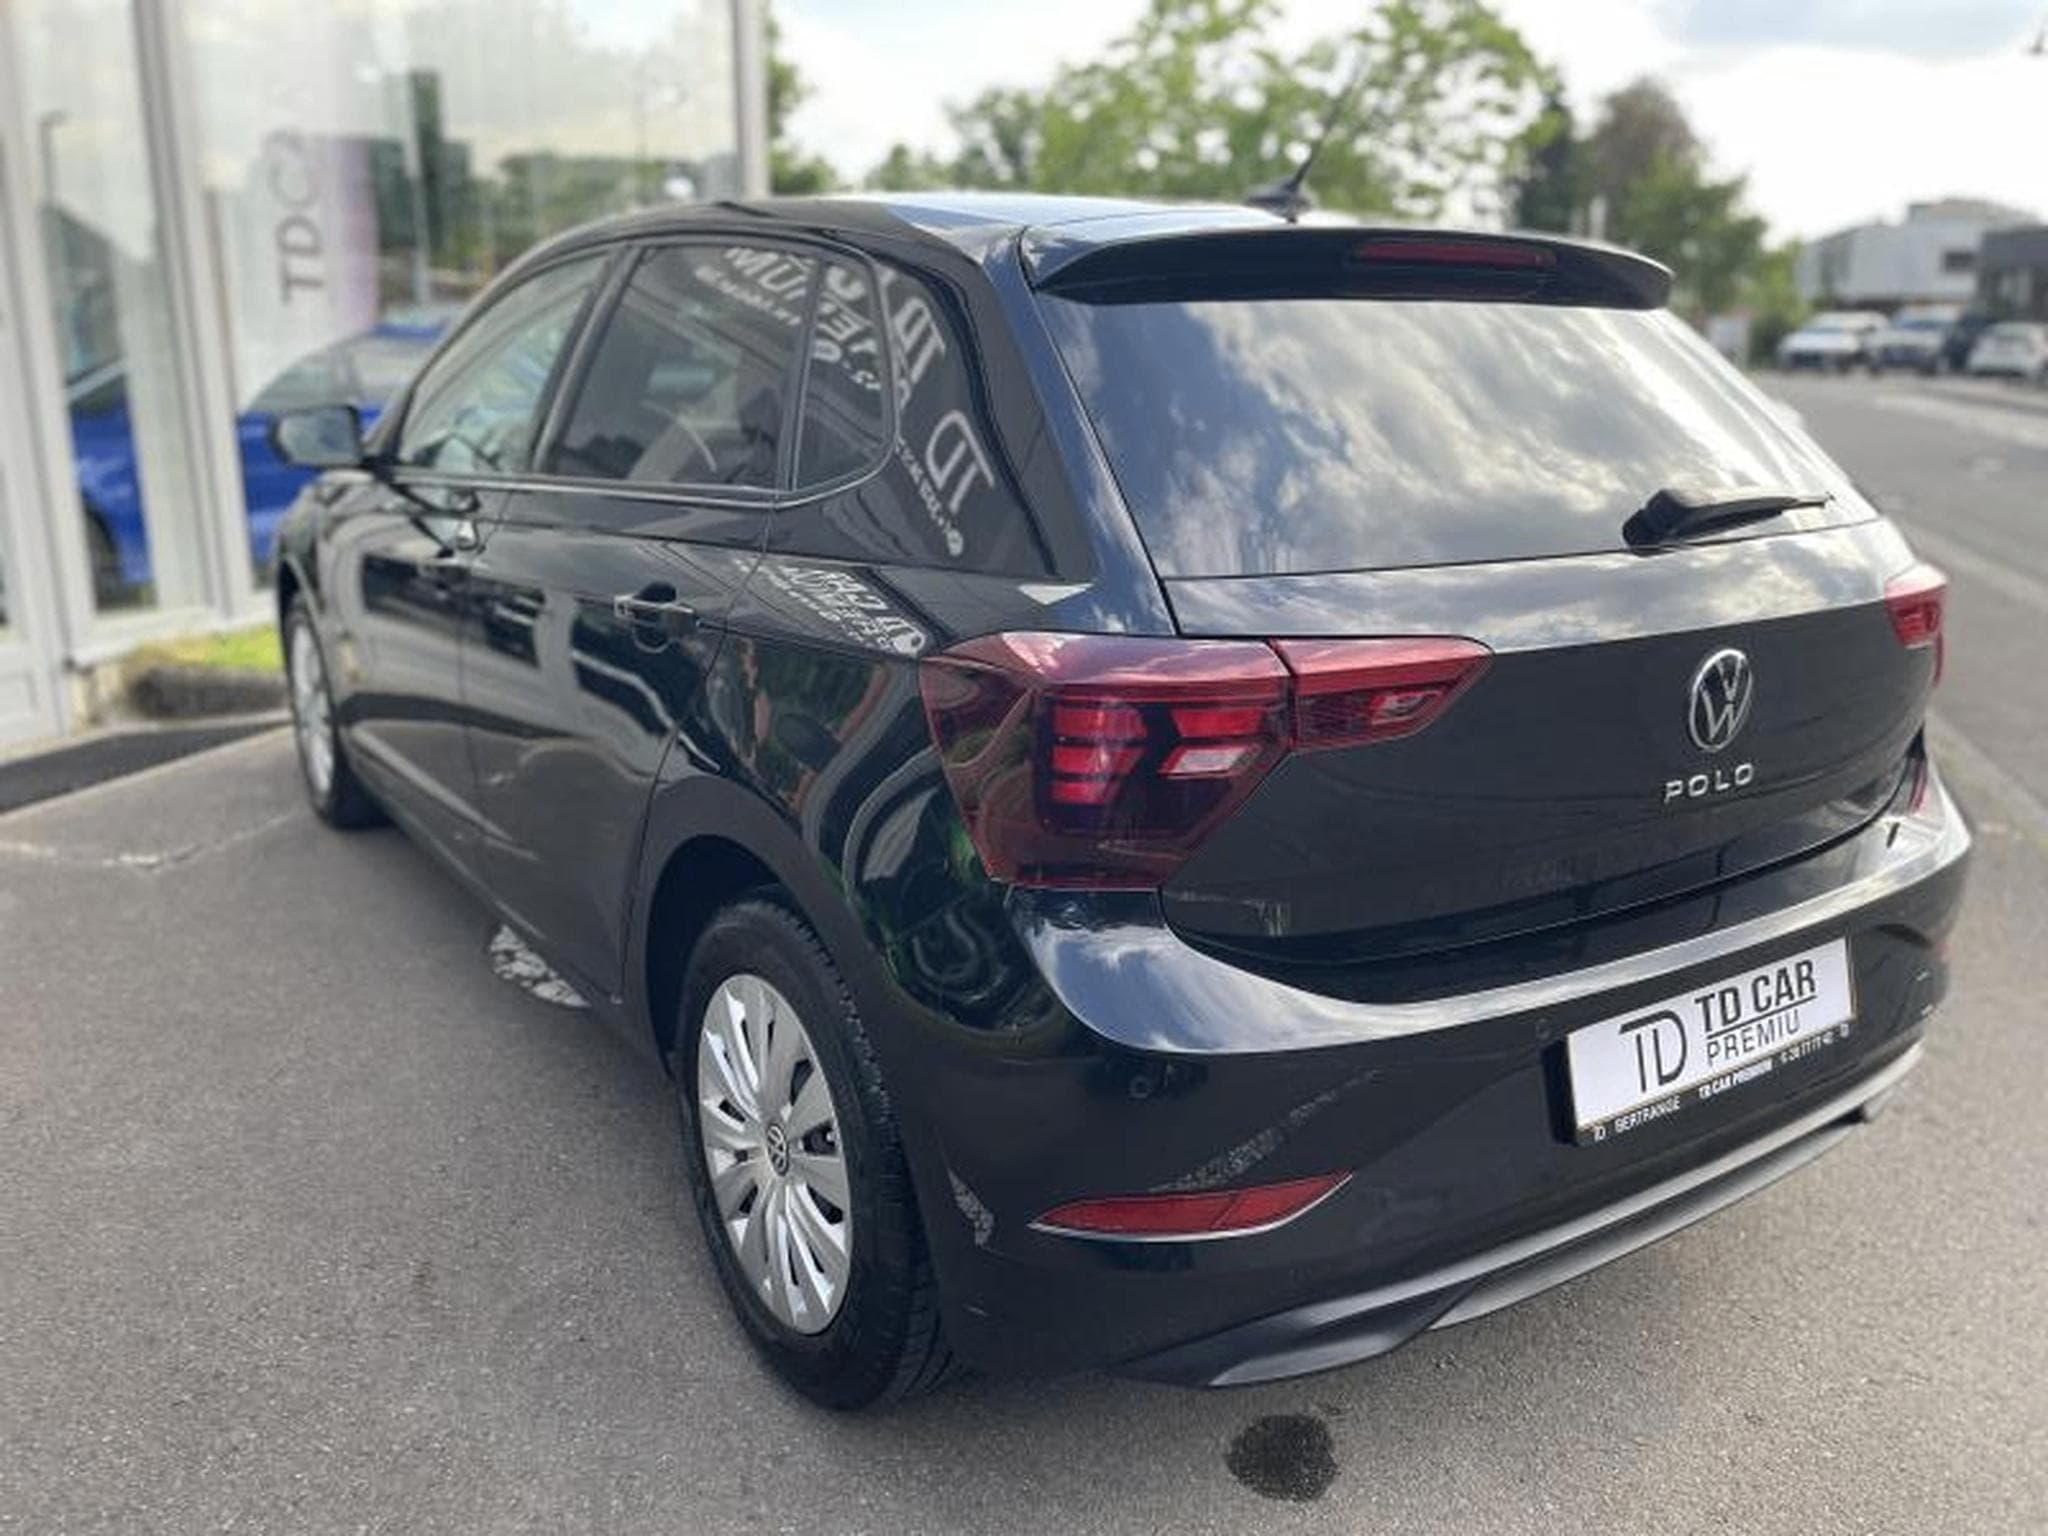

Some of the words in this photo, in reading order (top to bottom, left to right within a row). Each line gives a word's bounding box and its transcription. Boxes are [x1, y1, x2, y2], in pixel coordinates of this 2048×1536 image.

[1664, 762, 1754, 805] POLO
[1694, 985, 1742, 1035] TD
[1750, 958, 1818, 1014] CAR
[1619, 1009, 1688, 1094] TD
